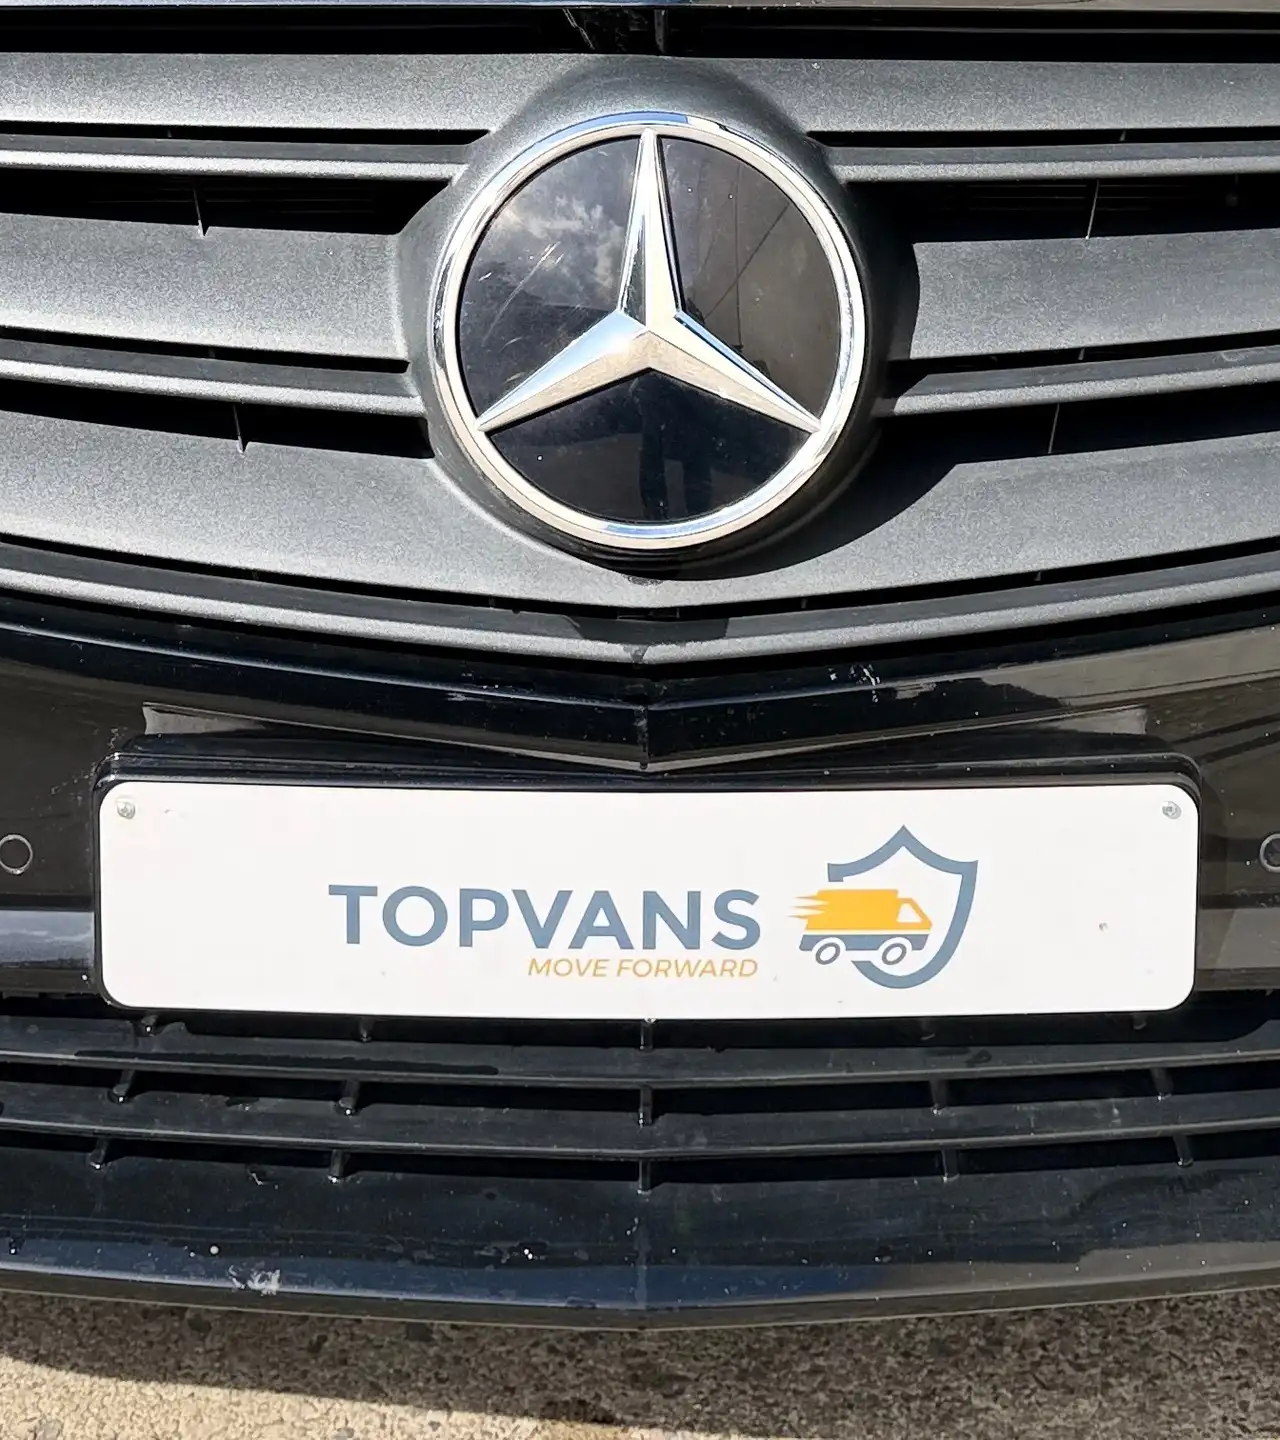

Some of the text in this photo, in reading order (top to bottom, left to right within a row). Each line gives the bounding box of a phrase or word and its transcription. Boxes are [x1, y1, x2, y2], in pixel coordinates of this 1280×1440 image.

[328, 884, 761, 951] TOPVANS
[527, 958, 758, 979] MOVE FORWARD
